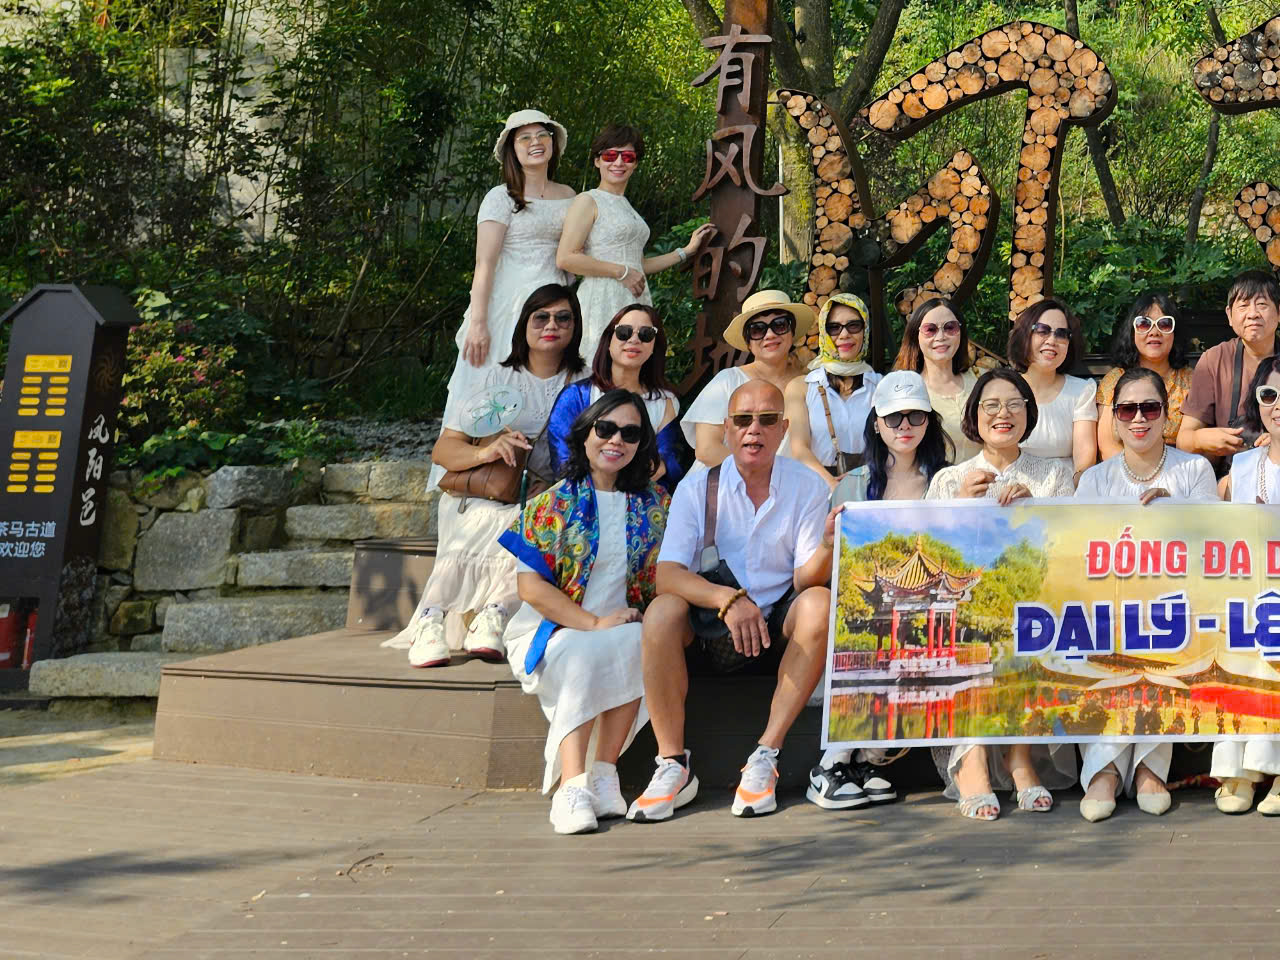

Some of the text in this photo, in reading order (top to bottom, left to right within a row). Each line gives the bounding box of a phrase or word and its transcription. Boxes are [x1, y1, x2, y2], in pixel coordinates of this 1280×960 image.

[0, 520, 57, 538] 茶马古道
[0, 541, 46, 558] 欢迎您
[1086, 526, 1188, 576] ĐỐNG
[1202, 540, 1252, 576] ĐA
[1124, 593, 1188, 651] LÝ
